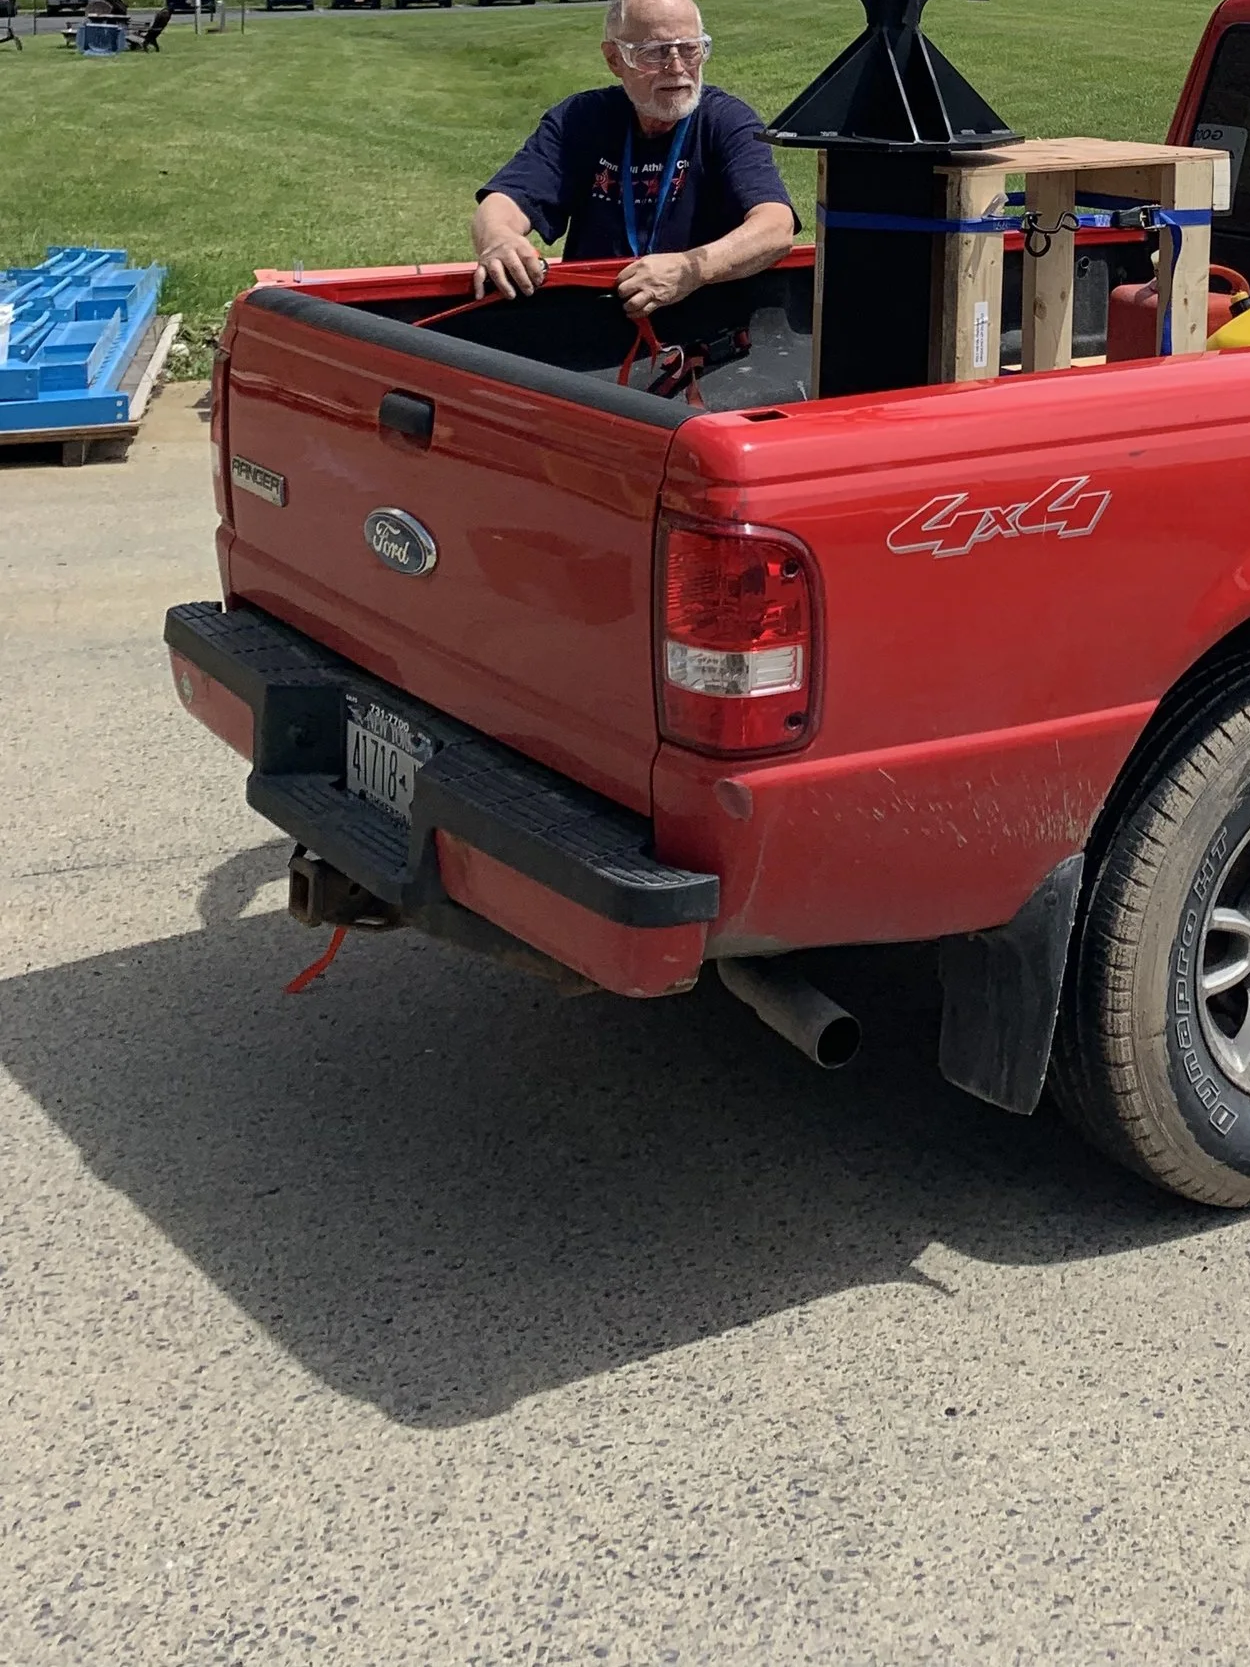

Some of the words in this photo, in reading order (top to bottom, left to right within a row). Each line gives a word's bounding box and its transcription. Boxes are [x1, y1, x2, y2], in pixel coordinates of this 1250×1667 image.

[231, 457, 281, 496] RANGER
[372, 520, 410, 566] Ford
[886, 475, 1112, 559] 4x4
[1173, 910, 1240, 1136] Dynapro
